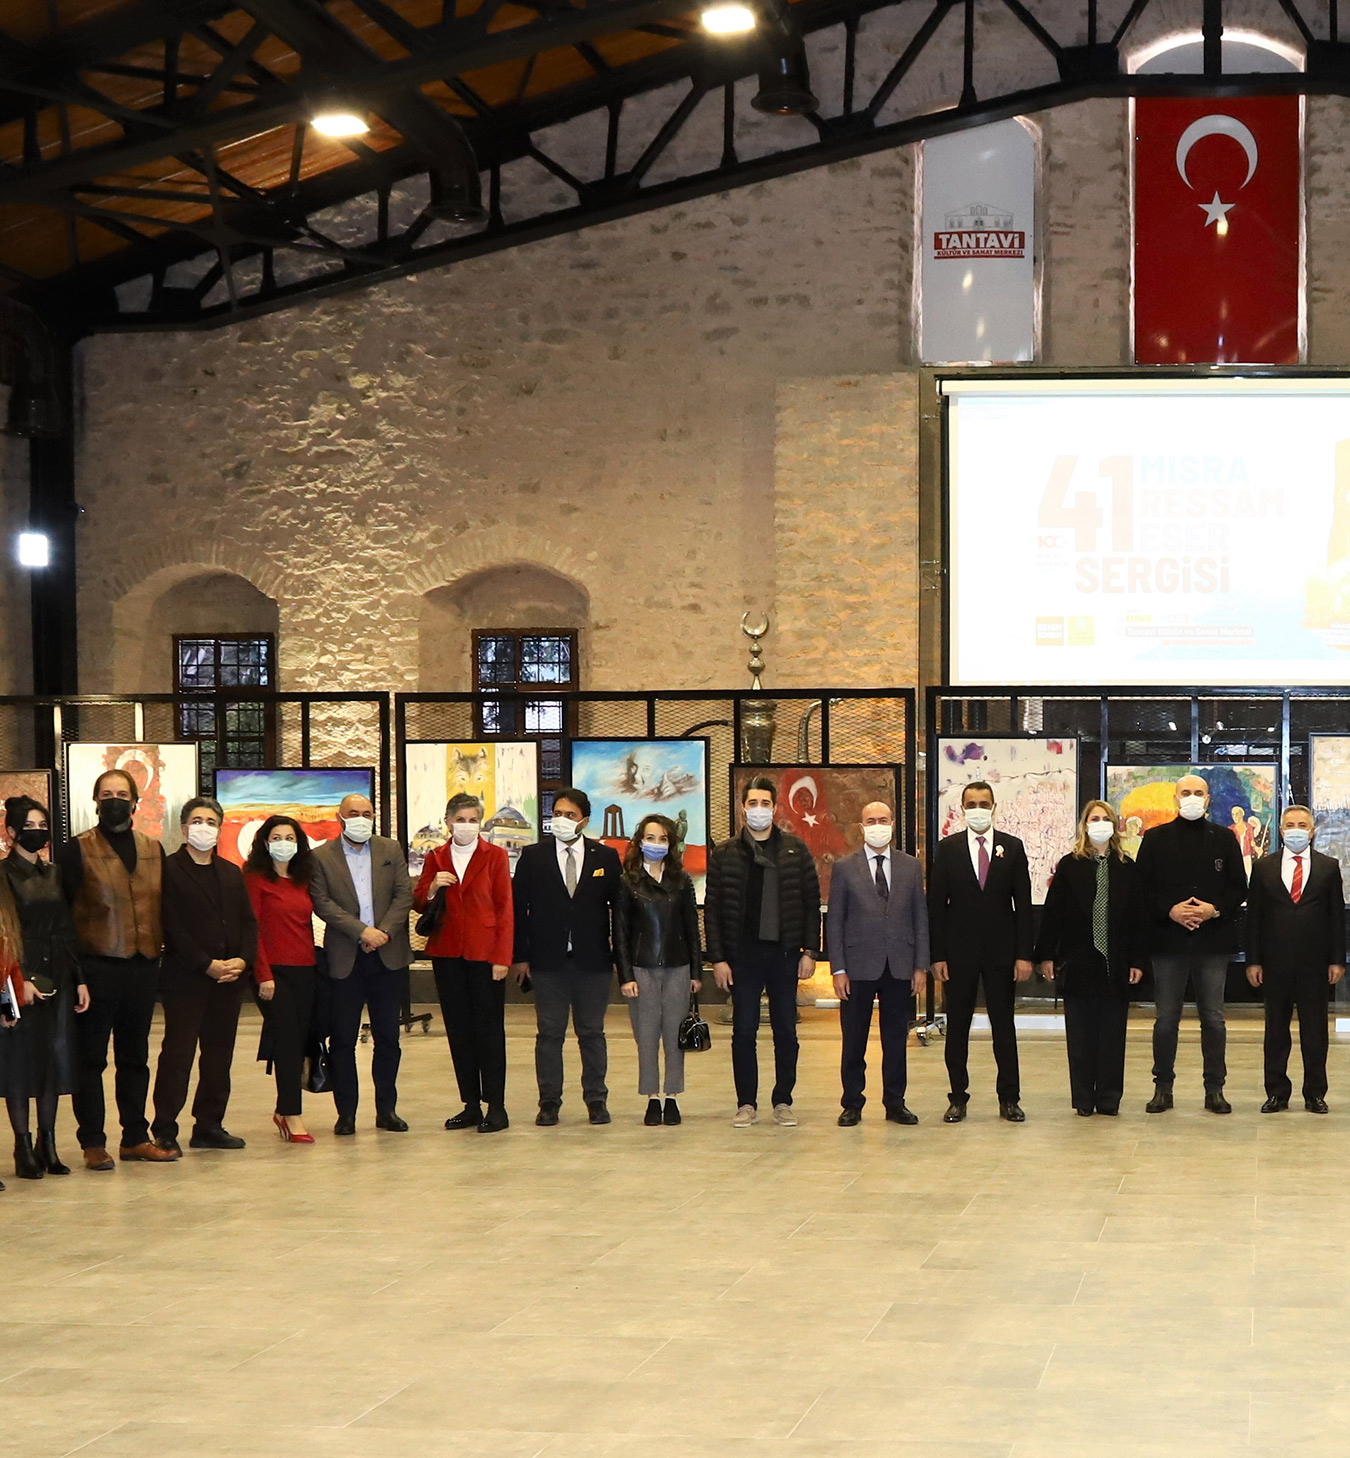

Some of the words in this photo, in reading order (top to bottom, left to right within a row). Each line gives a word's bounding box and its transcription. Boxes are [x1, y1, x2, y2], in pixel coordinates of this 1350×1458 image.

[1139, 455, 1249, 485] MISRA
[1036, 454, 1134, 553] 41
[1139, 488, 1286, 518] RESSAM
[1139, 523, 1229, 552] ESER
